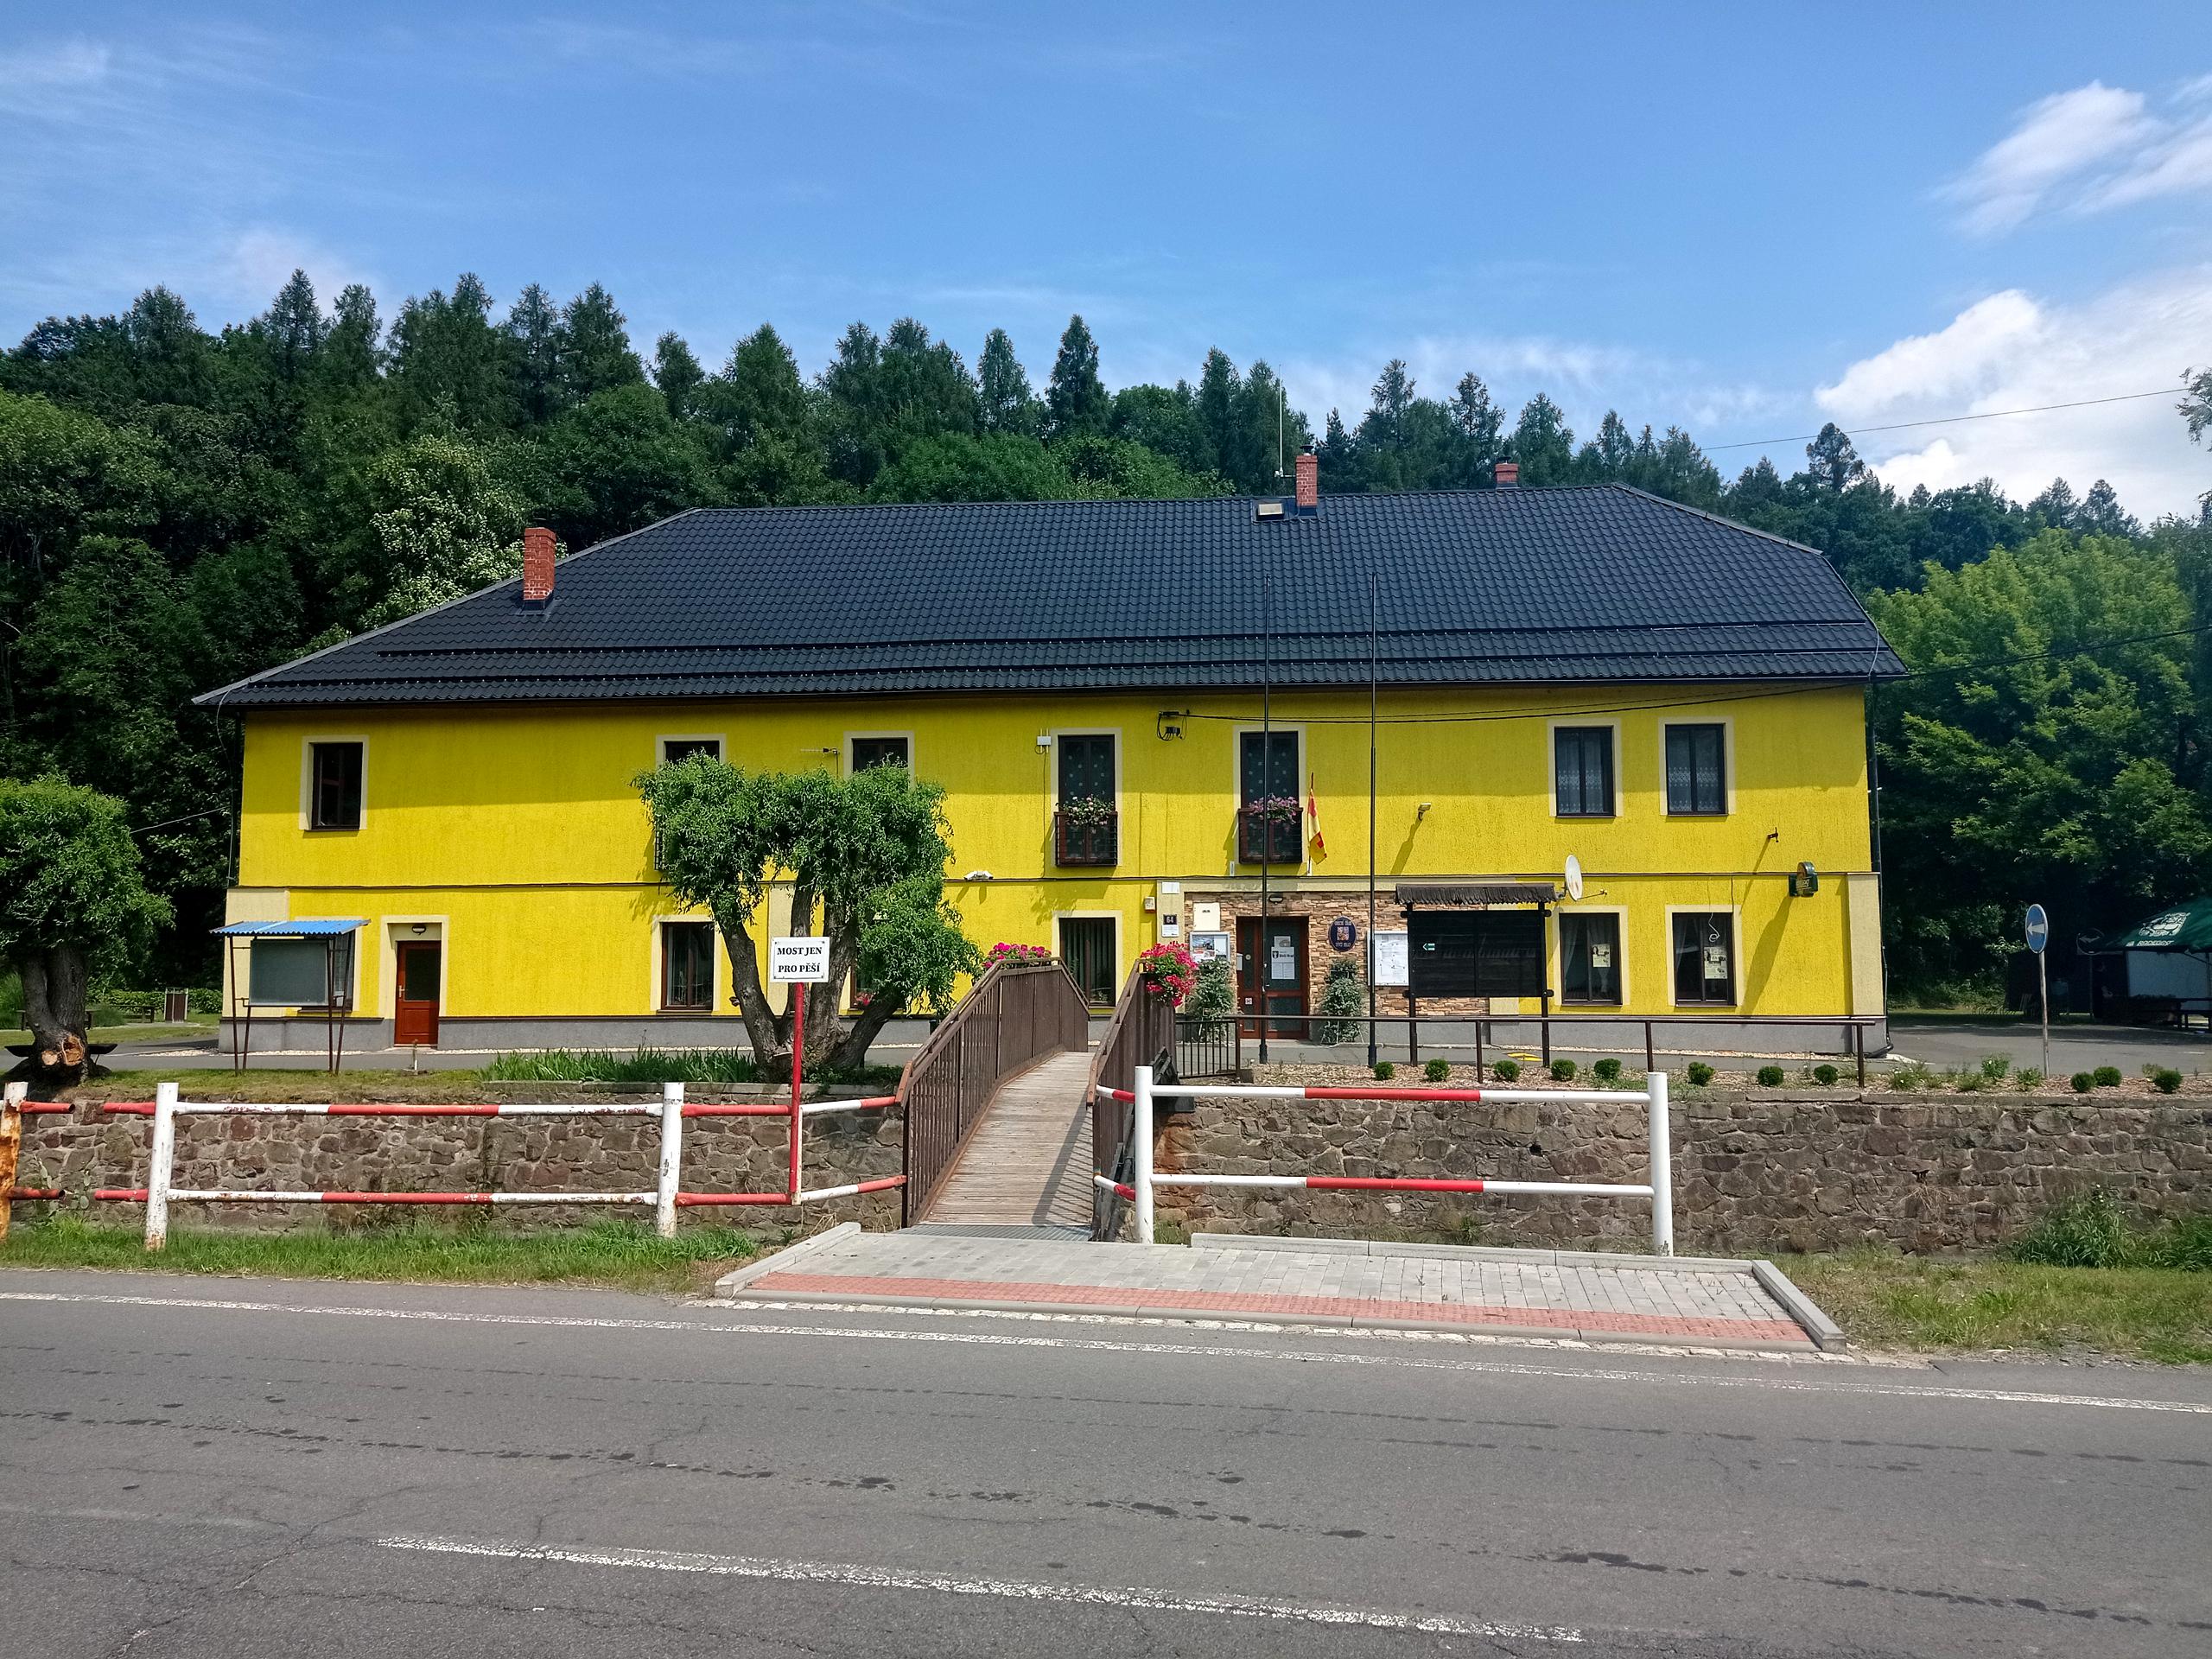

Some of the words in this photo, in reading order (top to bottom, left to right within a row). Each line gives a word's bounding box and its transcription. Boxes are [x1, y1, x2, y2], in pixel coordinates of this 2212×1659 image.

[804, 947, 822, 956] JEN
[778, 964, 798, 973] PRO
[799, 963, 820, 973] PĚŠÍ
